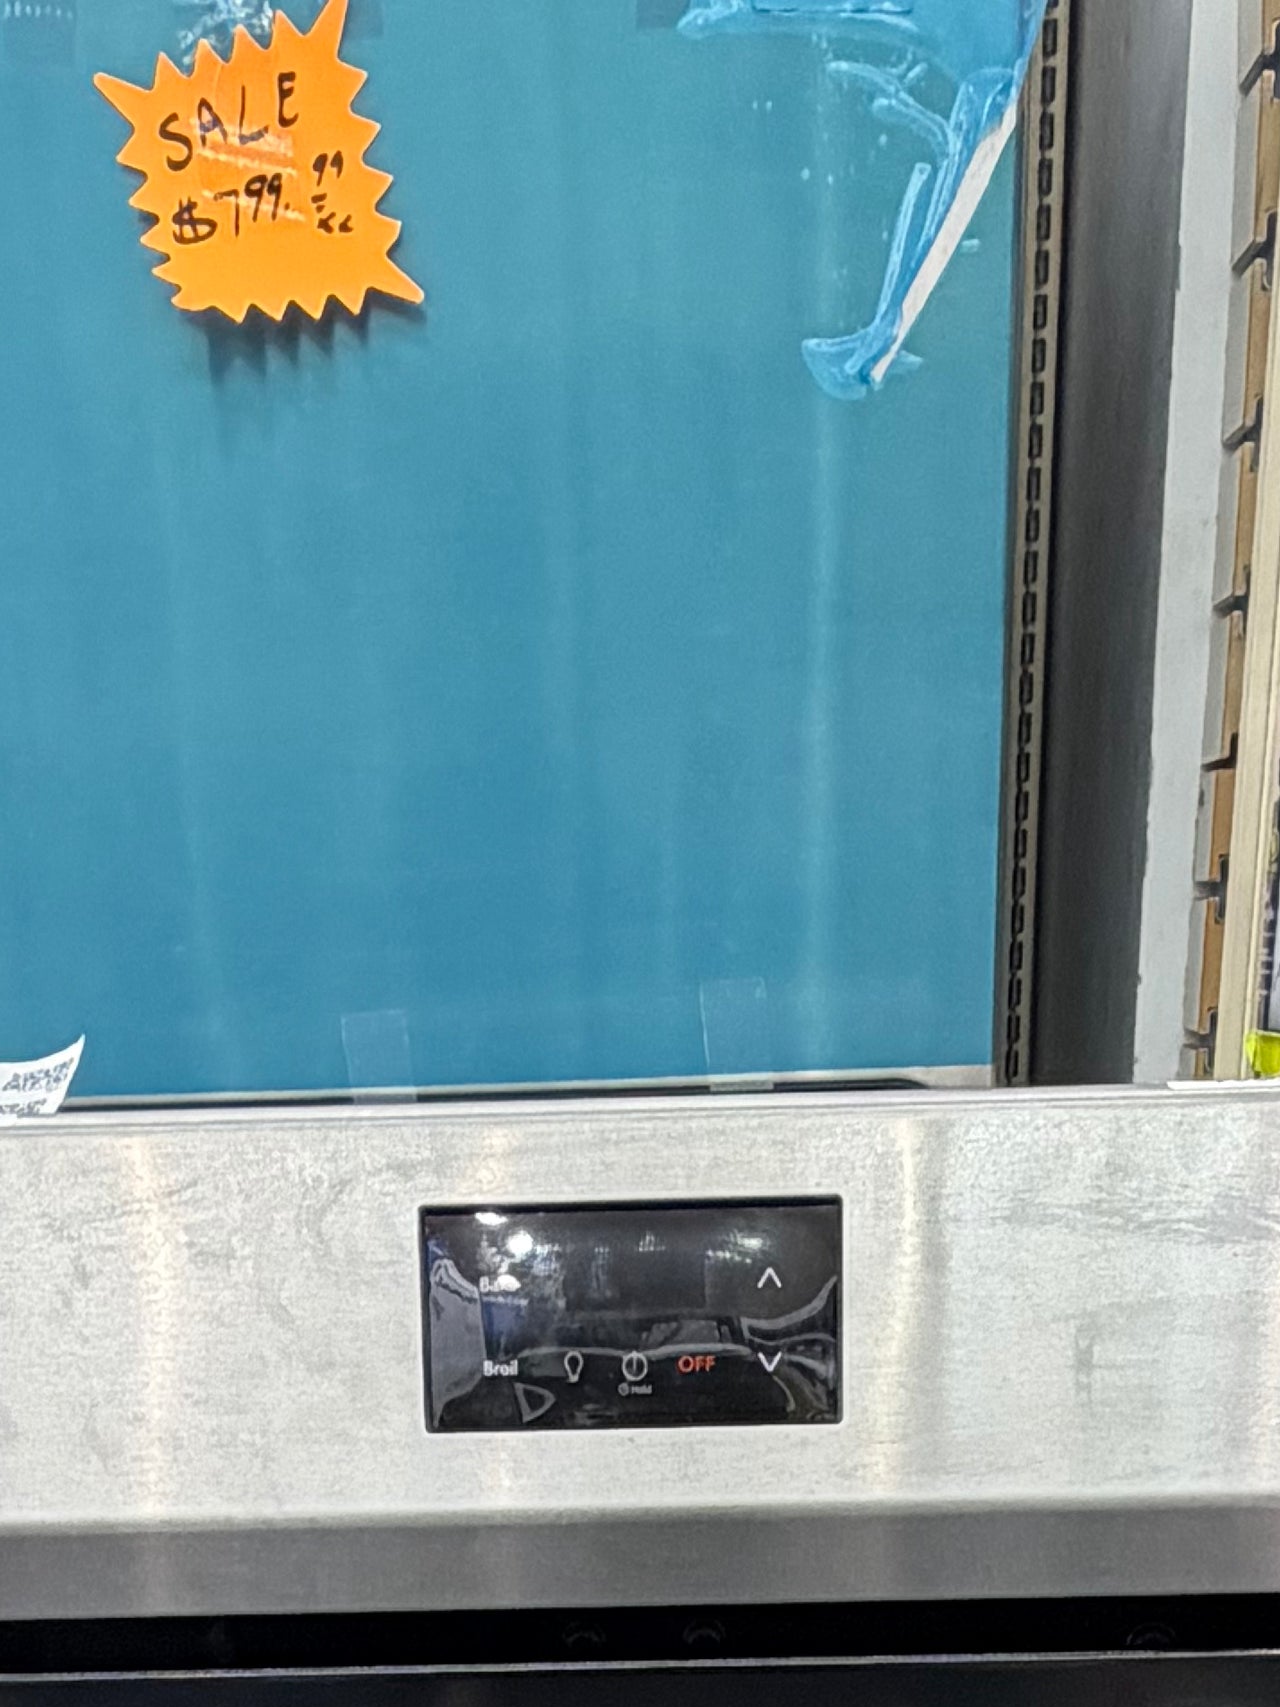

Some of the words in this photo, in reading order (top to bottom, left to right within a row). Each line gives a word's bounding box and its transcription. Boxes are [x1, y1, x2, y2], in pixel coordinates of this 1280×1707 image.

[159, 72, 299, 171] SALE
[482, 1358, 519, 1377] Broil
[677, 1355, 717, 1375] OFF
